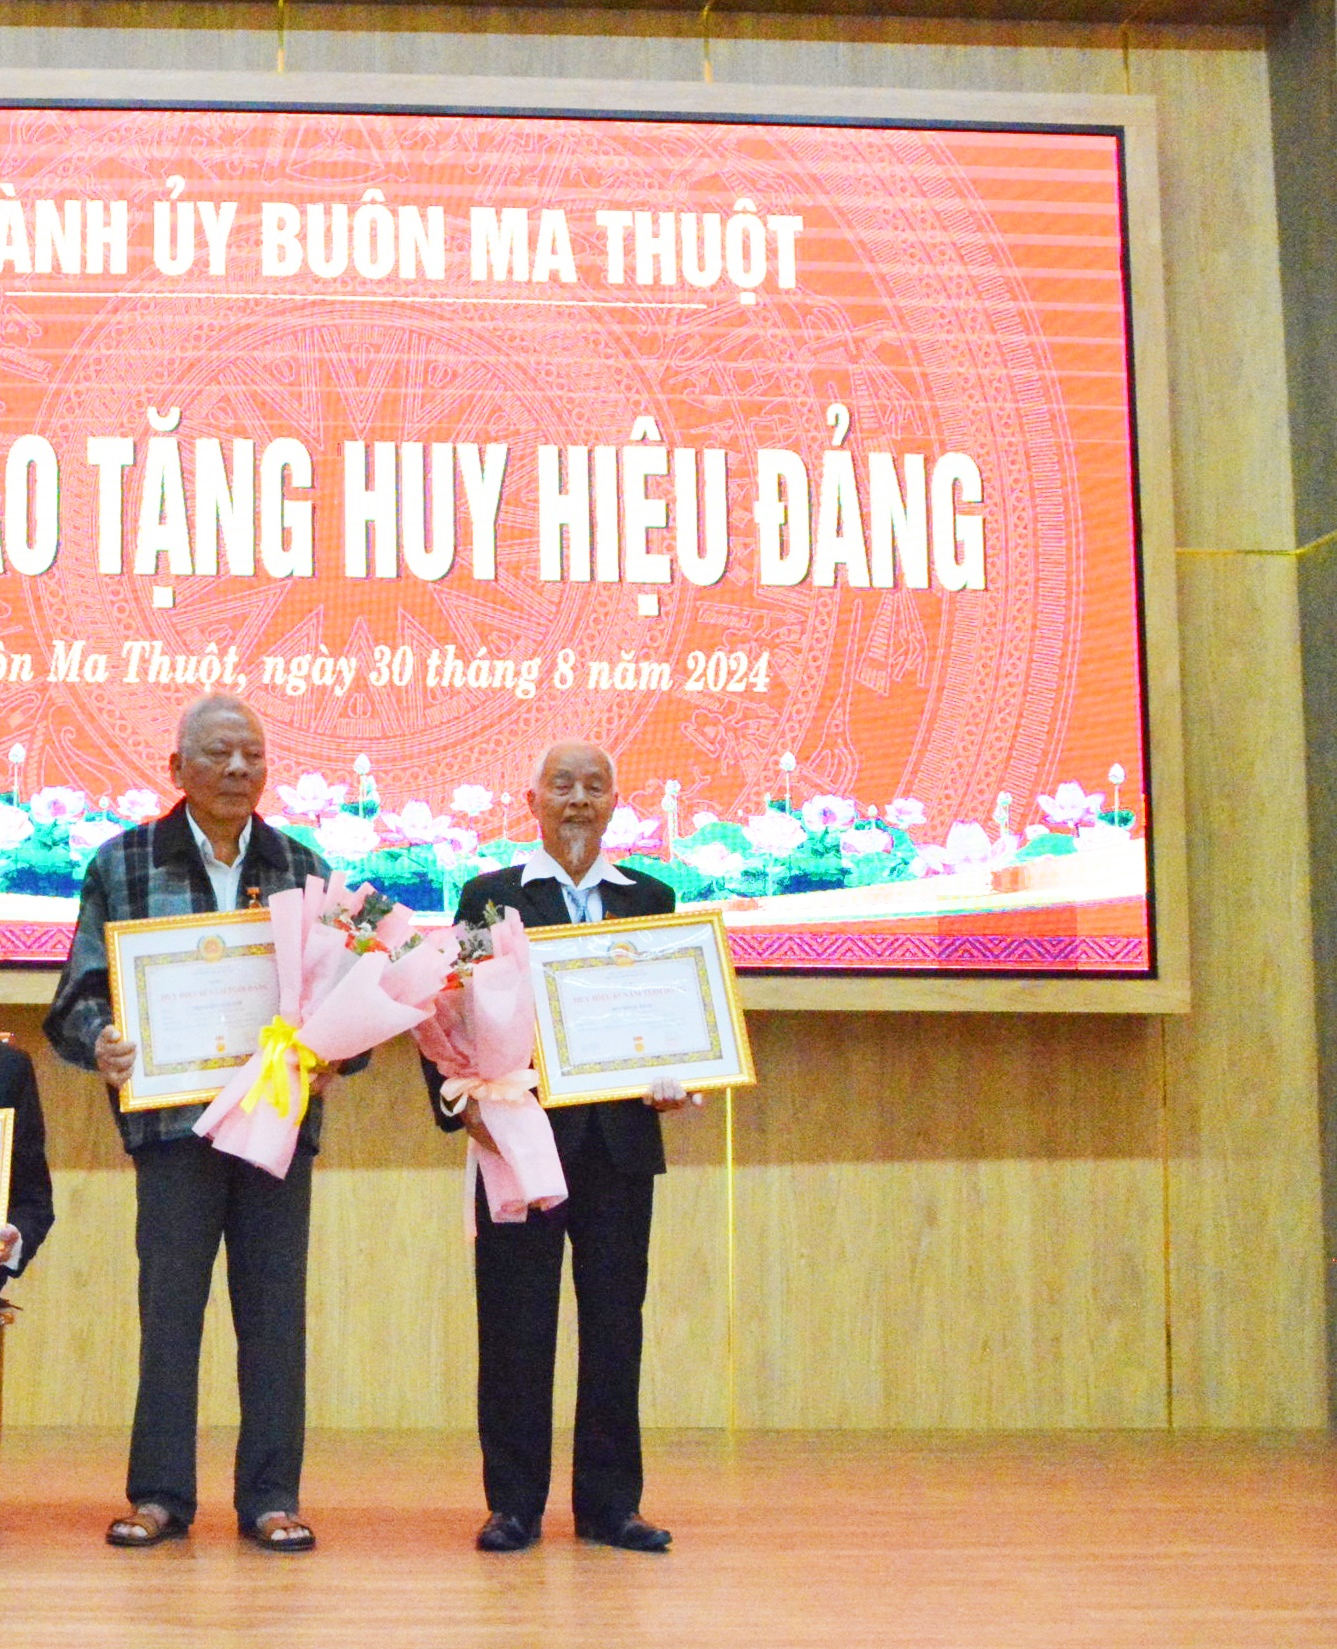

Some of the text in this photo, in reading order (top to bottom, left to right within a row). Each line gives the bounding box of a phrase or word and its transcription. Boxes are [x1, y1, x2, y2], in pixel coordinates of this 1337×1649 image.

[151, 174, 237, 276] ỦY
[261, 187, 444, 279] BUÔN
[471, 208, 578, 283] MA
[596, 196, 803, 305] THUỘT
[87, 407, 314, 609] TẶNG
[344, 440, 509, 585] HUY
[538, 416, 728, 617] HIỆU
[753, 403, 985, 592] ĐẢNG
[46, 639, 110, 684] Ma
[121, 640, 248, 694] Thuột,
[261, 643, 357, 699] ngày
[368, 645, 415, 687] 30
[426, 645, 542, 699] tháng
[553, 648, 576, 691] 8
[587, 650, 674, 692] năm
[683, 650, 770, 693] 2024
